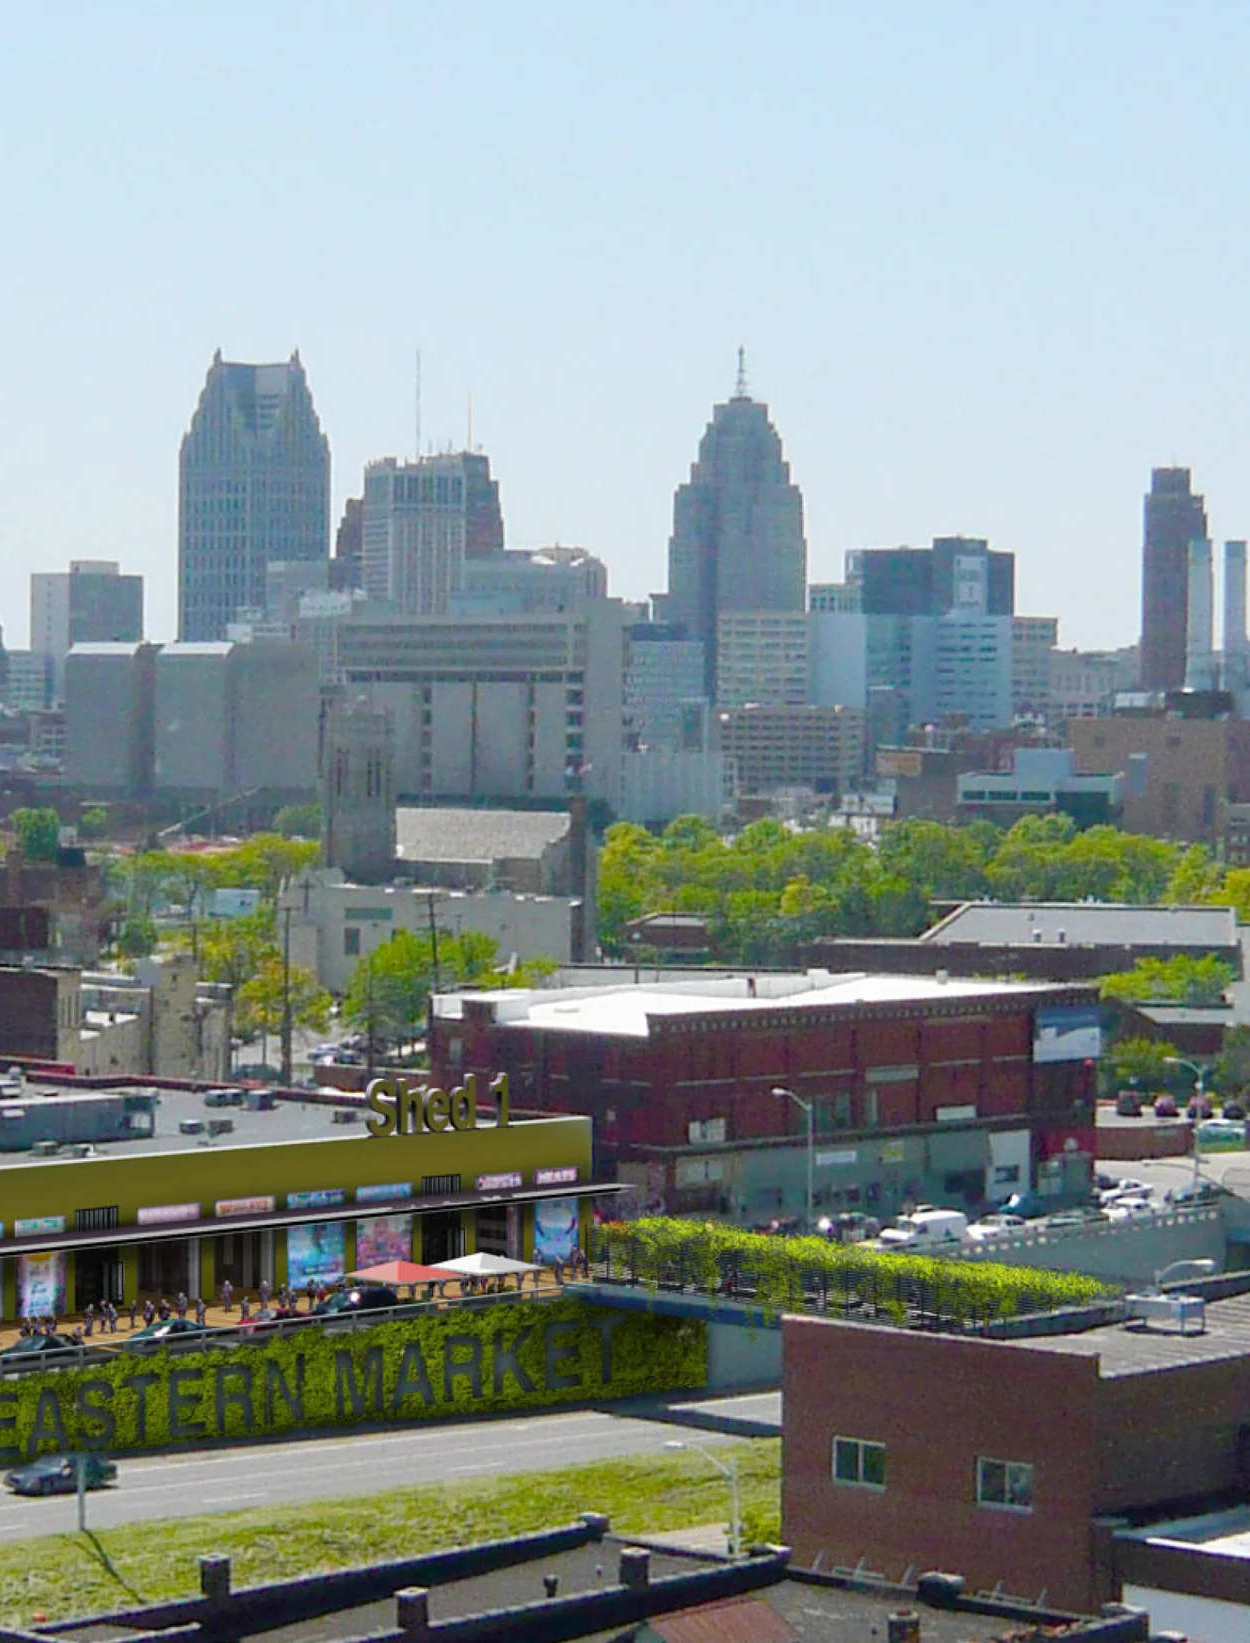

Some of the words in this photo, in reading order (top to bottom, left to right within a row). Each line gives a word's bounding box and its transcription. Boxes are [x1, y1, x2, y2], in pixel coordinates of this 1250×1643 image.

[365, 1073, 478, 1138] Shed
[488, 1072, 511, 1129] 1
[335, 1313, 627, 1417] MARKET
